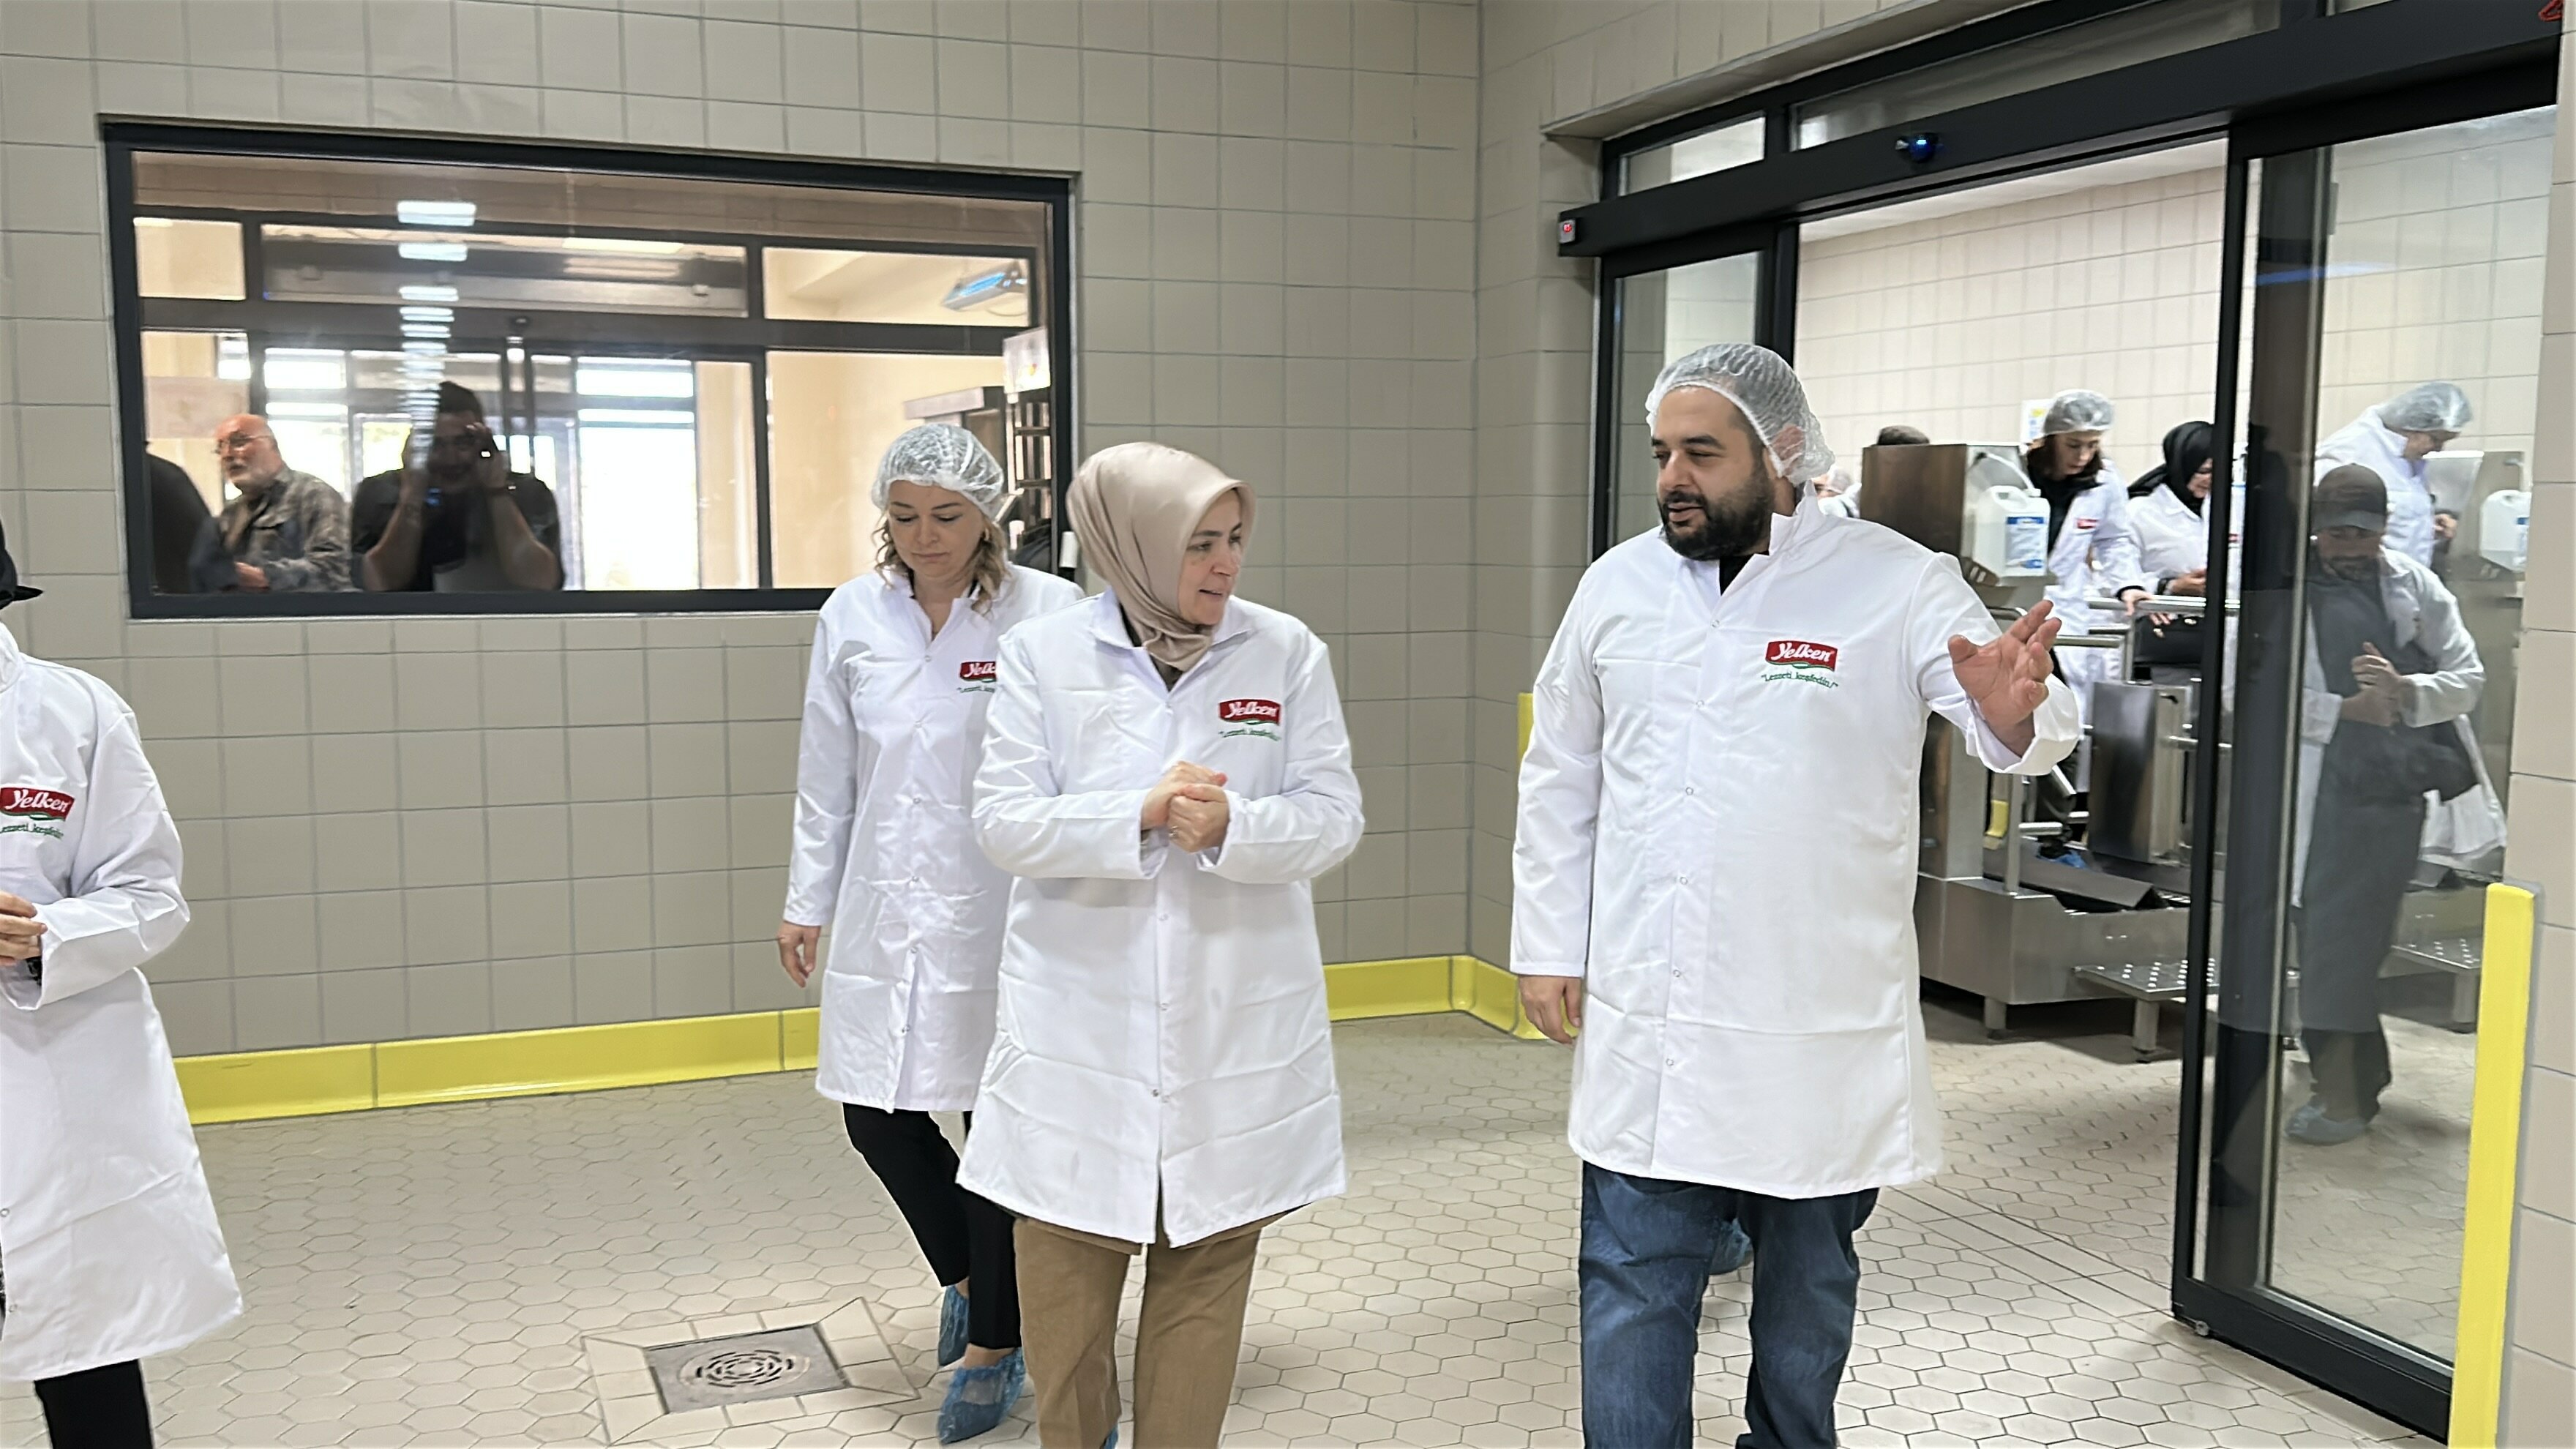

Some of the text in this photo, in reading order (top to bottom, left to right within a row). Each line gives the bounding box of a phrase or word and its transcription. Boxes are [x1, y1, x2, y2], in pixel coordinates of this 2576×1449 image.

[1771, 642, 1834, 662] Yelken
[963, 662, 996, 678] Yelk
[1224, 700, 1278, 719] Yelken
[4, 789, 70, 812] Yelken
